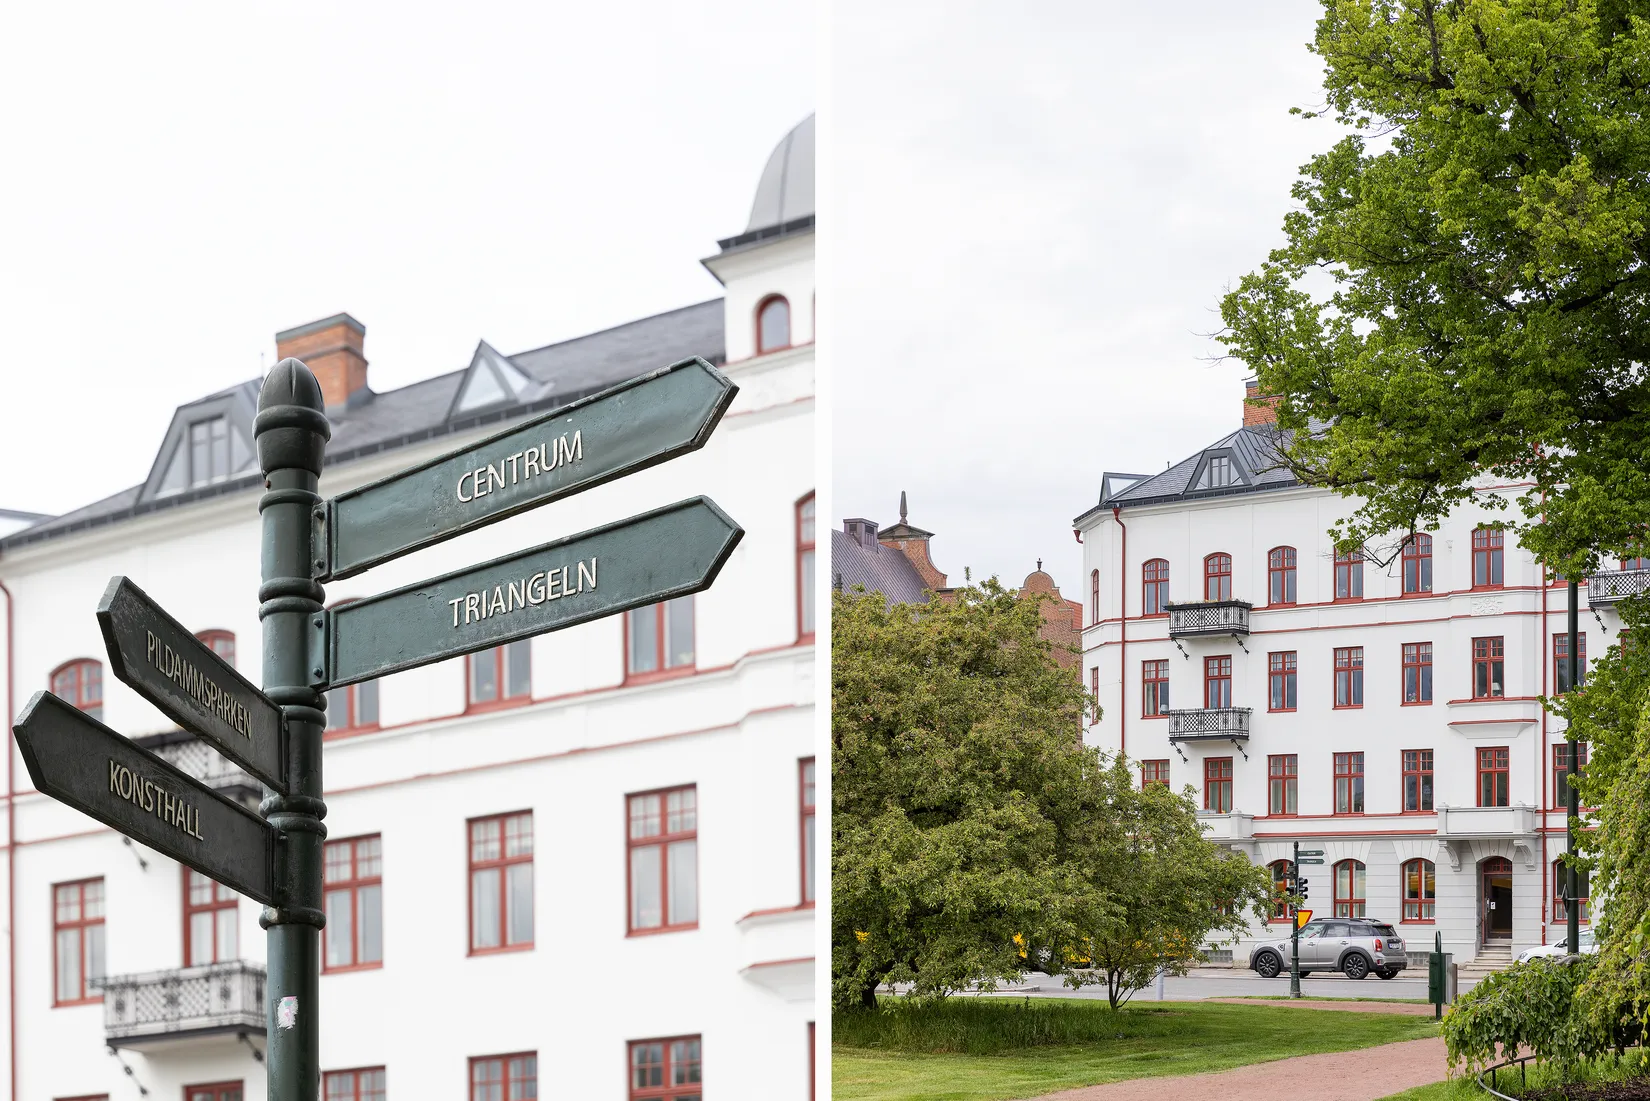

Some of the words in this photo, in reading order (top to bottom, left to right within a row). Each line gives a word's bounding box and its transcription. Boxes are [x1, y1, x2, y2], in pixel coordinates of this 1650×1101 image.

[456, 430, 583, 503] CENTRUM
[449, 557, 598, 627] TRIANGELN
[146, 630, 252, 740] PILDAMMSPARKEN
[108, 760, 204, 841] KONSTHALL
